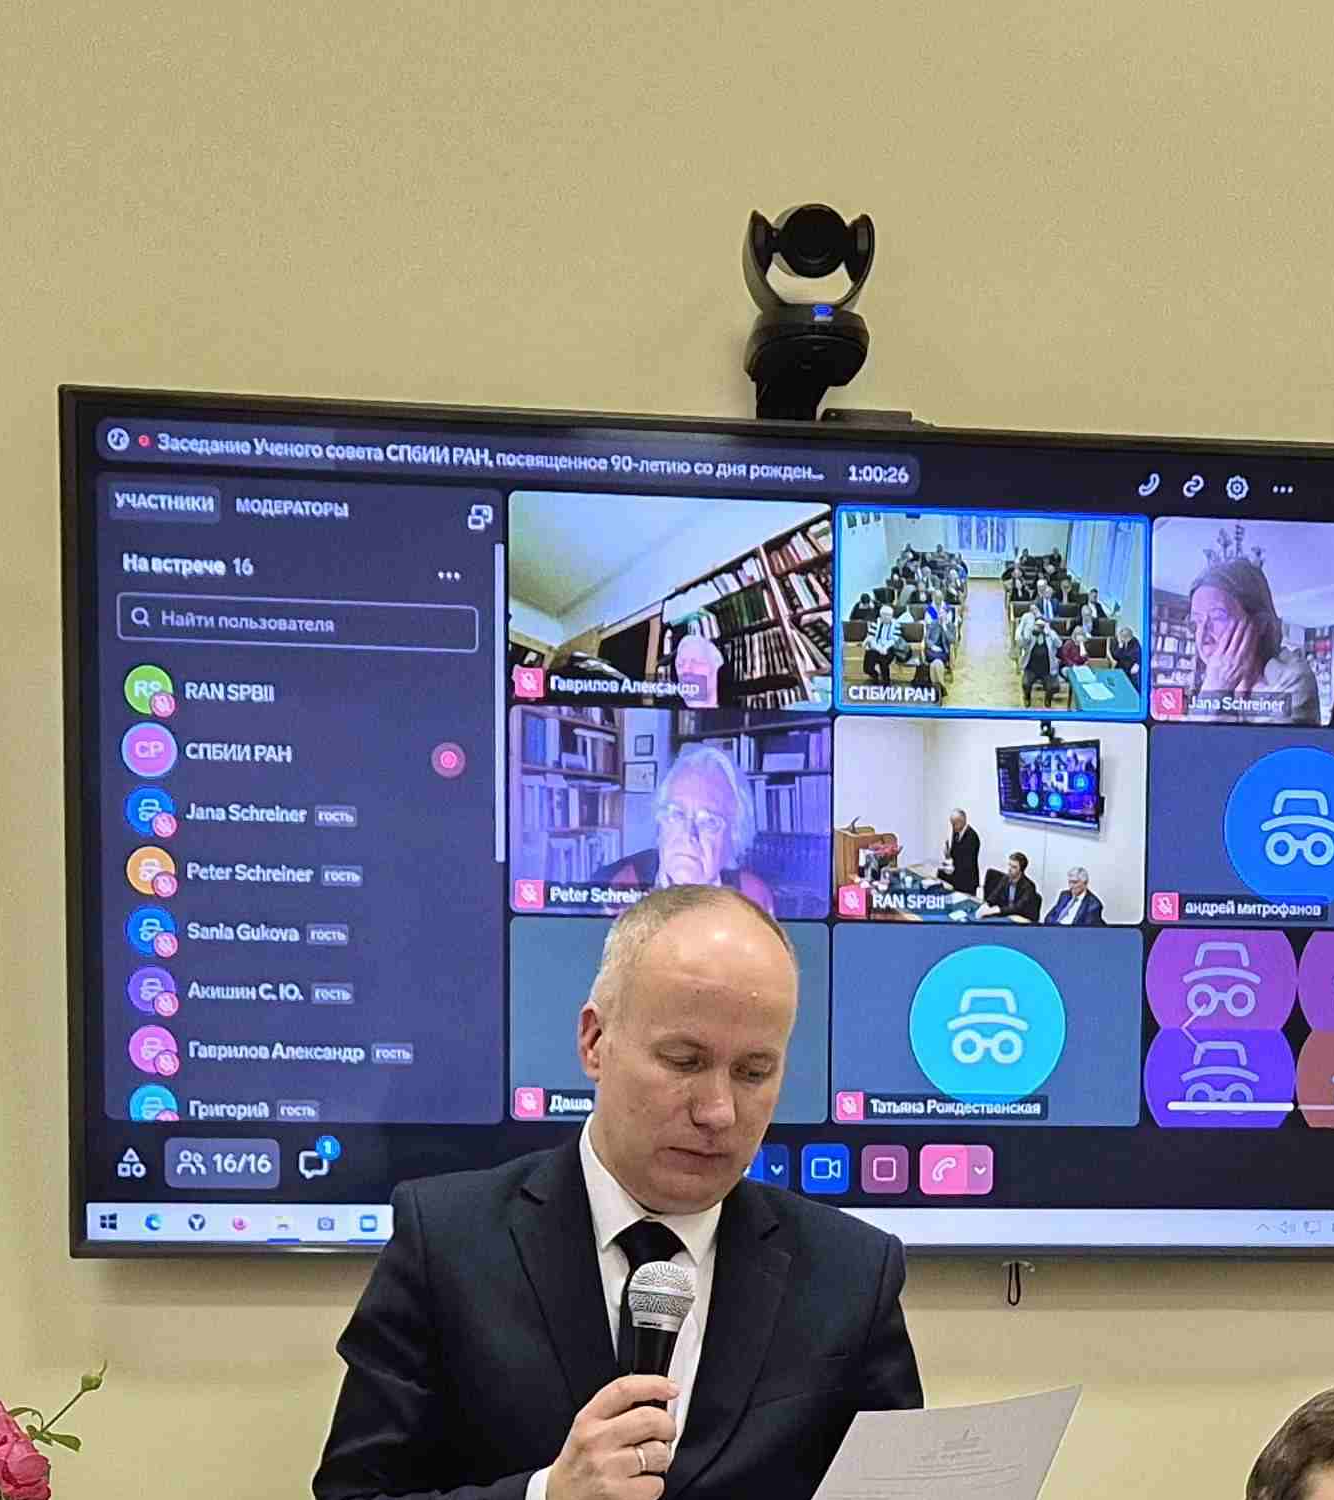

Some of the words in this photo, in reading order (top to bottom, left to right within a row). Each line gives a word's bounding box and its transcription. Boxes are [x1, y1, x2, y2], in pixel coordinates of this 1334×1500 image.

[157, 433, 251, 456] Заседание
[254, 437, 323, 460] Ученого
[326, 444, 384, 461] совета
[452, 447, 494, 467] РАН,
[496, 452, 608, 473] посвященное
[610, 455, 691, 475] 90-летию
[693, 463, 714, 475] со
[715, 463, 747, 479] дня
[849, 464, 909, 484] 1:00:26
[115, 490, 215, 513] УЧАСТНИКИ
[235, 497, 349, 518] МОДЕРАТОРЫ
[122, 554, 149, 573] На
[150, 558, 227, 578] встрече
[233, 557, 254, 576] 16
[160, 610, 215, 629] Найти
[218, 615, 335, 634] пользователя
[185, 682, 224, 700] RAN
[226, 683, 275, 702] SPBII
[549, 675, 619, 694] Гаврилов
[848, 685, 903, 701] СПБИИ
[904, 687, 936, 702] РАН
[1188, 695, 1220, 710] Jana
[1221, 696, 1285, 712] Schreiner
[185, 741, 251, 761] СПБИИ
[253, 743, 293, 763] РАН
[185, 803, 226, 821] Jana
[228, 803, 308, 824] Schreiner
[318, 810, 355, 824] гость
[186, 862, 232, 881] Peter
[234, 864, 314, 884] Schreiner
[324, 870, 361, 884] гость
[549, 886, 589, 902] Peter
[872, 893, 905, 909] RAN
[1185, 900, 1235, 917] андрей
[1237, 902, 1321, 918] митрофанов
[186, 922, 234, 941] Sania
[236, 923, 300, 943] Gukova
[310, 929, 347, 943] гость
[188, 981, 256, 1001] Акишин
[315, 988, 352, 1002] гость
[188, 1041, 269, 1062] Гаврилов
[271, 1043, 365, 1064] Александр
[375, 1047, 412, 1061] гость
[189, 1100, 269, 1121] Григорий
[279, 1104, 317, 1119] гость
[870, 1099, 925, 1114] Татьяна
[927, 1099, 1041, 1116] Рождественская
[323, 1141, 333, 1156] 1
[213, 1152, 272, 1175] 16/16
